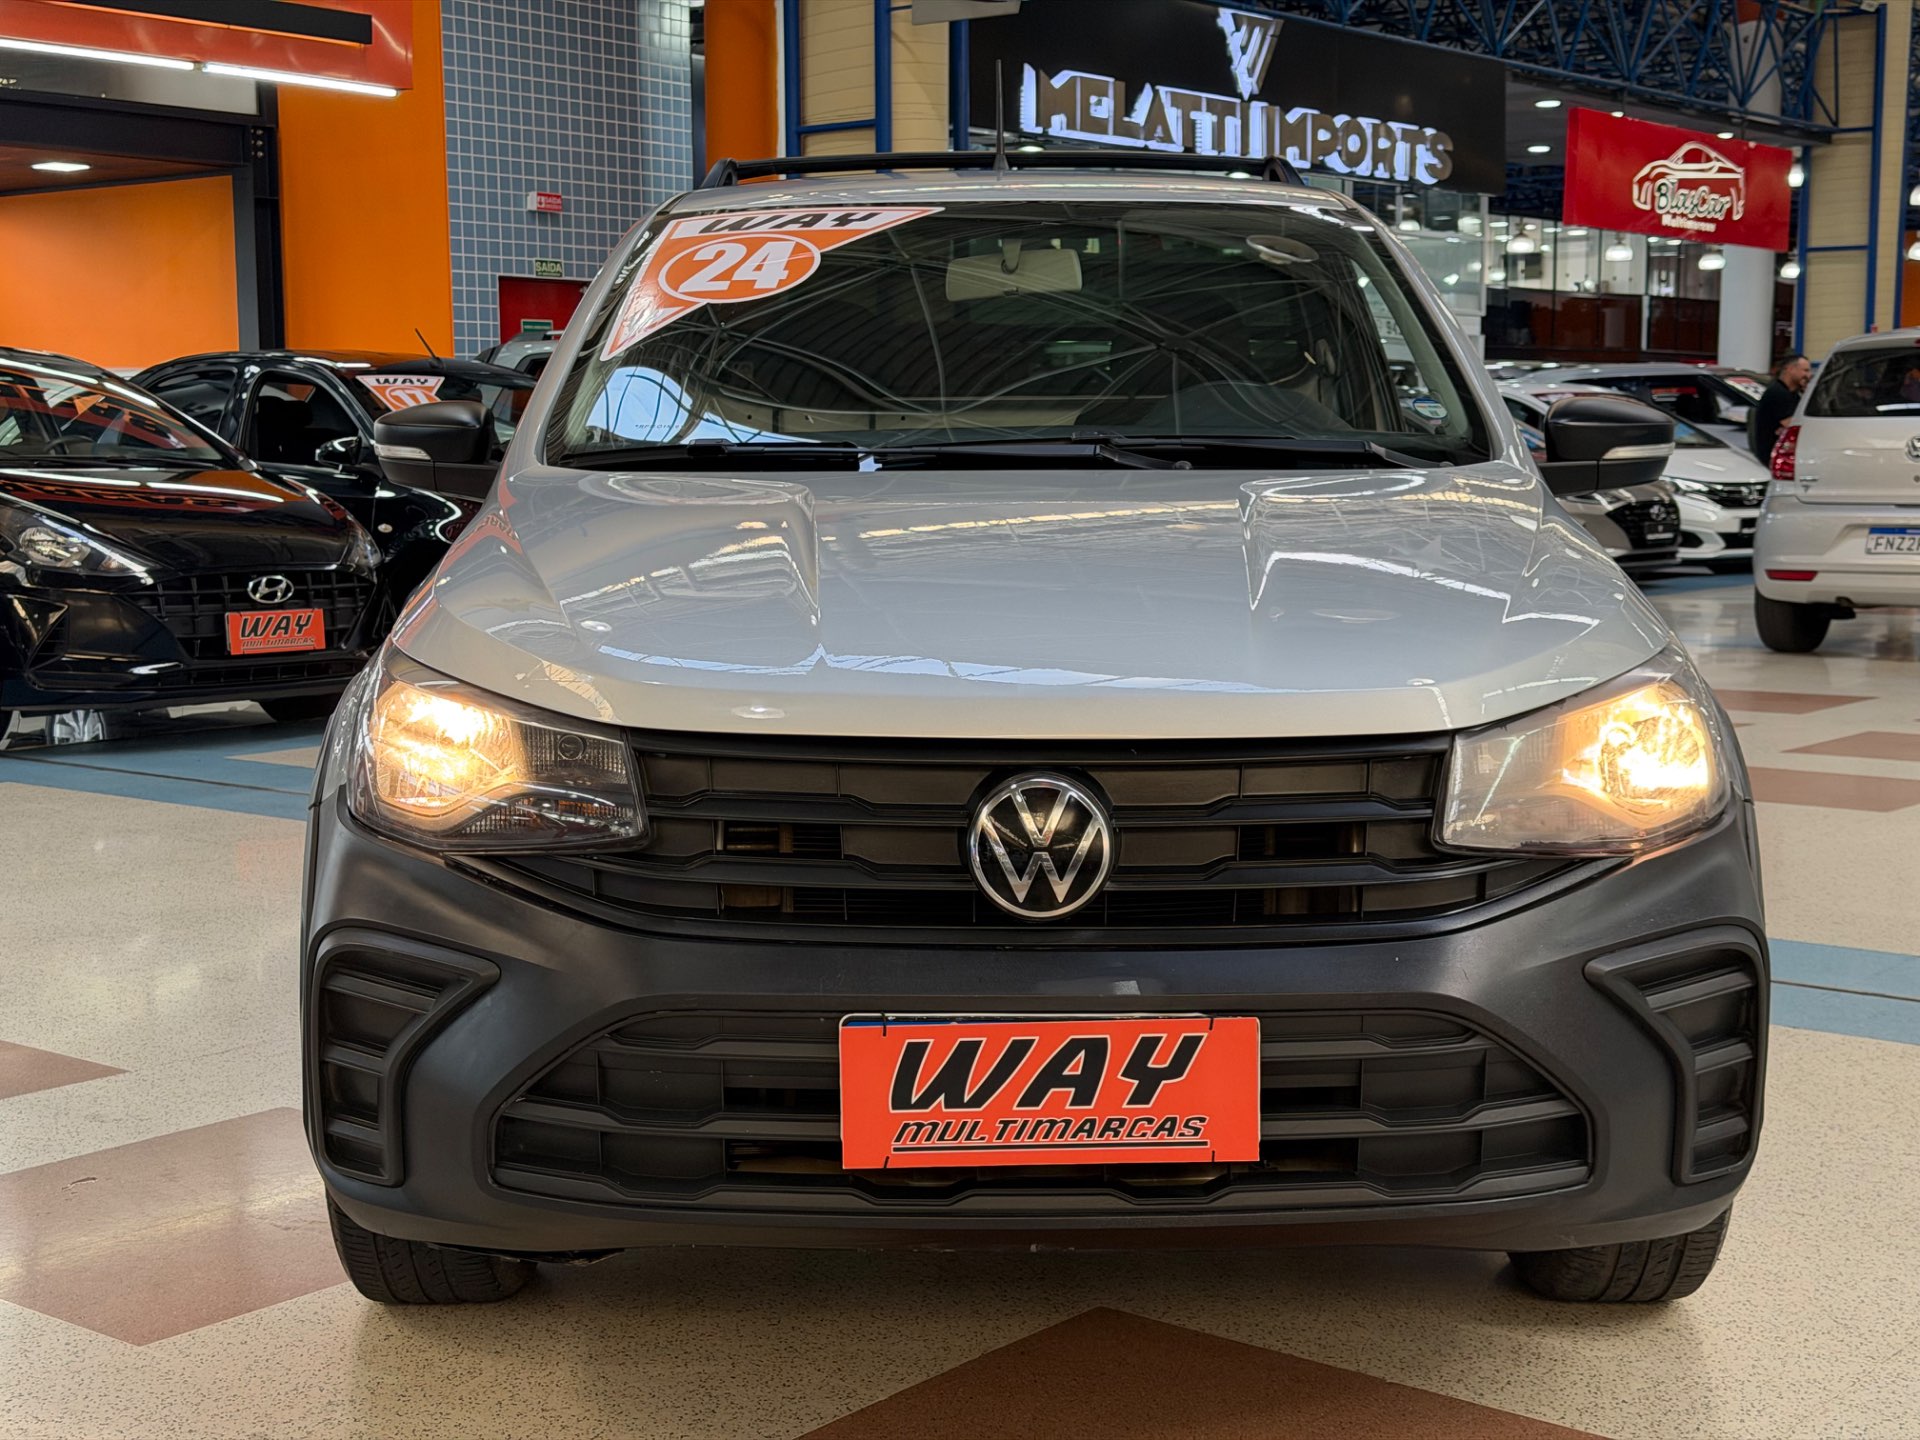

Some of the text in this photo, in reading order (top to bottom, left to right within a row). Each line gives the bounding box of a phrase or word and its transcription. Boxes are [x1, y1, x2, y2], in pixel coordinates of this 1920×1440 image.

[1022, 64, 1454, 184] MELATTI IMPORTS
[699, 212, 881, 234] WAY
[535, 261, 562, 273] SAÍDA
[677, 240, 797, 292] 24
[240, 612, 315, 639] WAY
[889, 1032, 1209, 1113] WAY
[893, 1115, 1209, 1144] MULTIMARCAS
